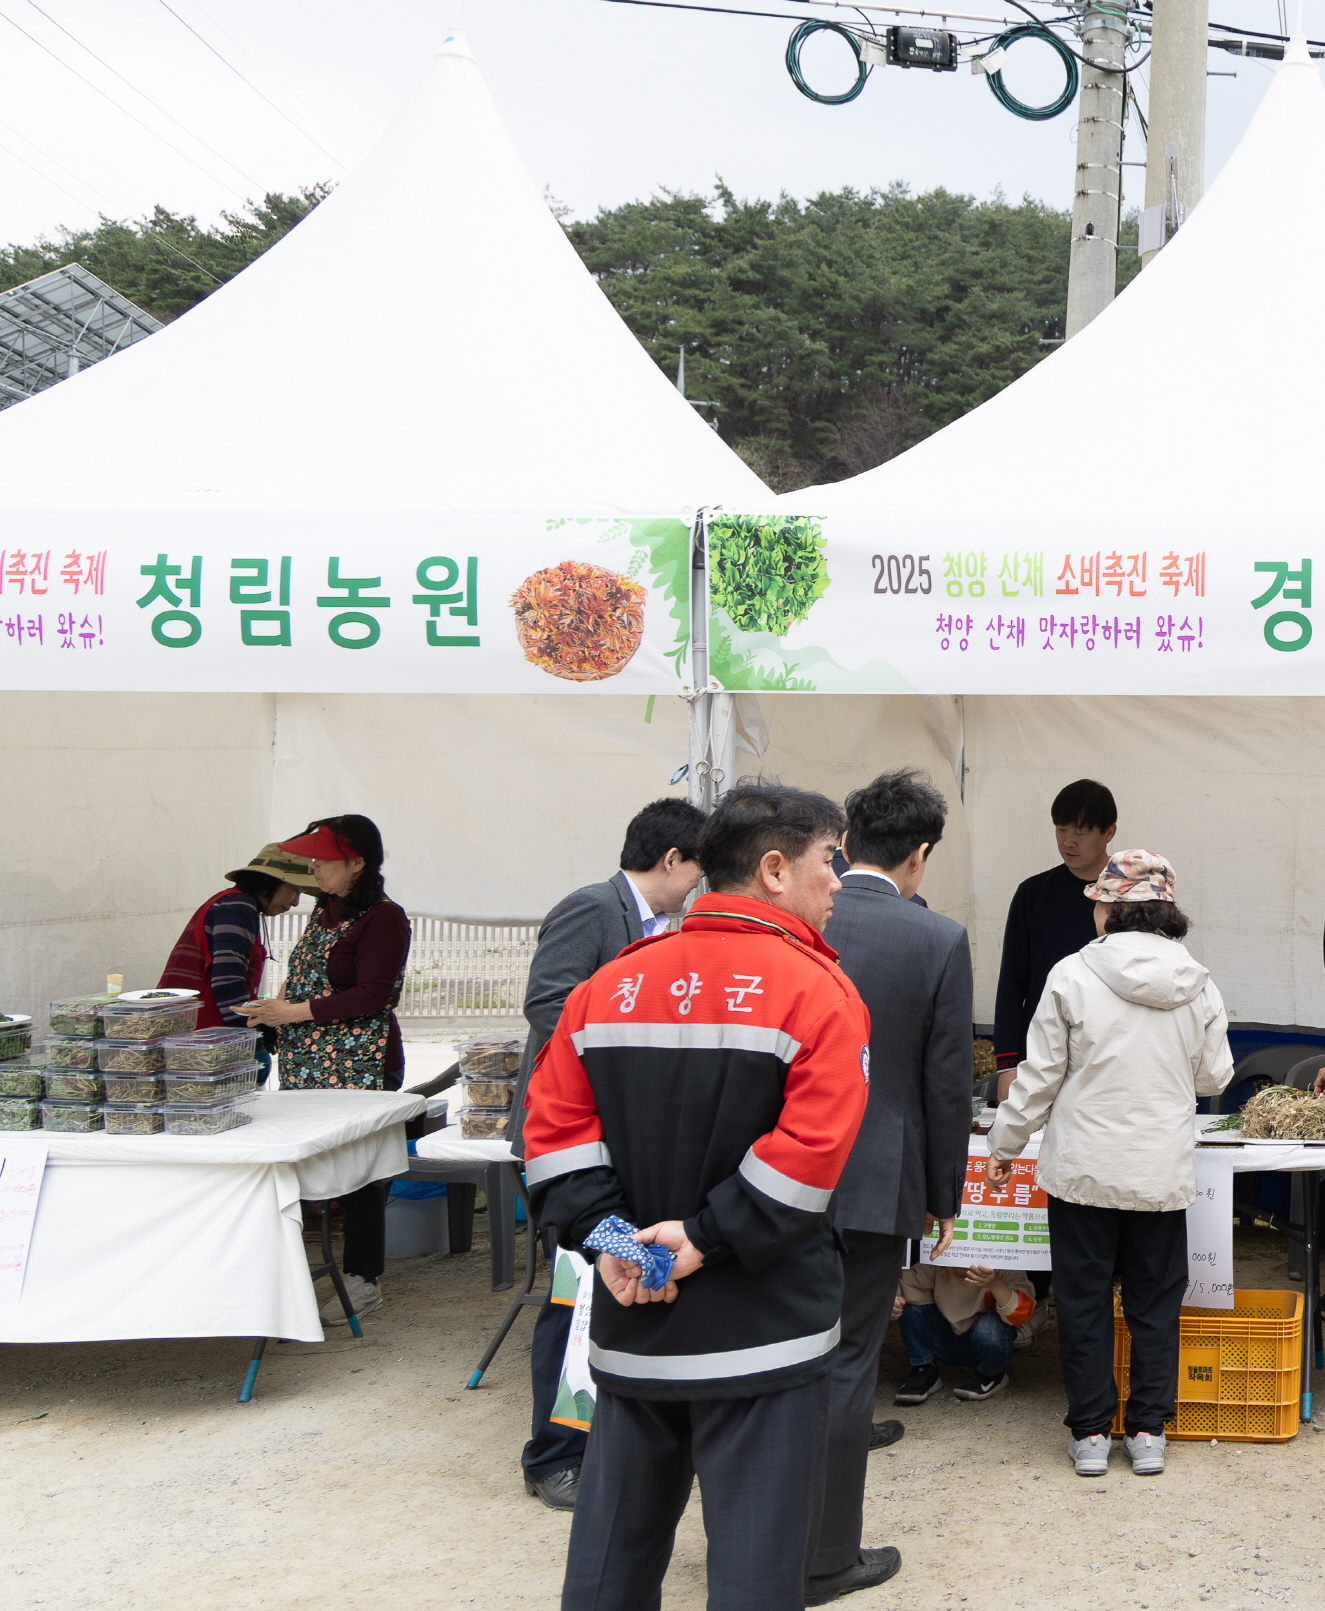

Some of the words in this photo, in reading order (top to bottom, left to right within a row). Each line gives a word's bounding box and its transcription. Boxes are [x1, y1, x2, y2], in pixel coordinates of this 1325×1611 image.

[0, 549, 51, 595] 촉진
[60, 549, 107, 595] 축제
[872, 554, 932, 595] 2025
[943, 551, 987, 598] 청양
[998, 551, 1044, 597] 산채
[1056, 551, 1147, 598] 소비촉진
[1159, 551, 1205, 597] 축제
[136, 552, 482, 650] 청림농원
[0, 613, 43, 646] 하러
[57, 612, 104, 650] 왔슈!
[936, 613, 974, 651] 청양
[986, 614, 1026, 651] 산채
[1039, 614, 1141, 651] 맛자랑하러
[1155, 614, 1204, 652] 왔슈!
[609, 972, 764, 1015] 청양군
